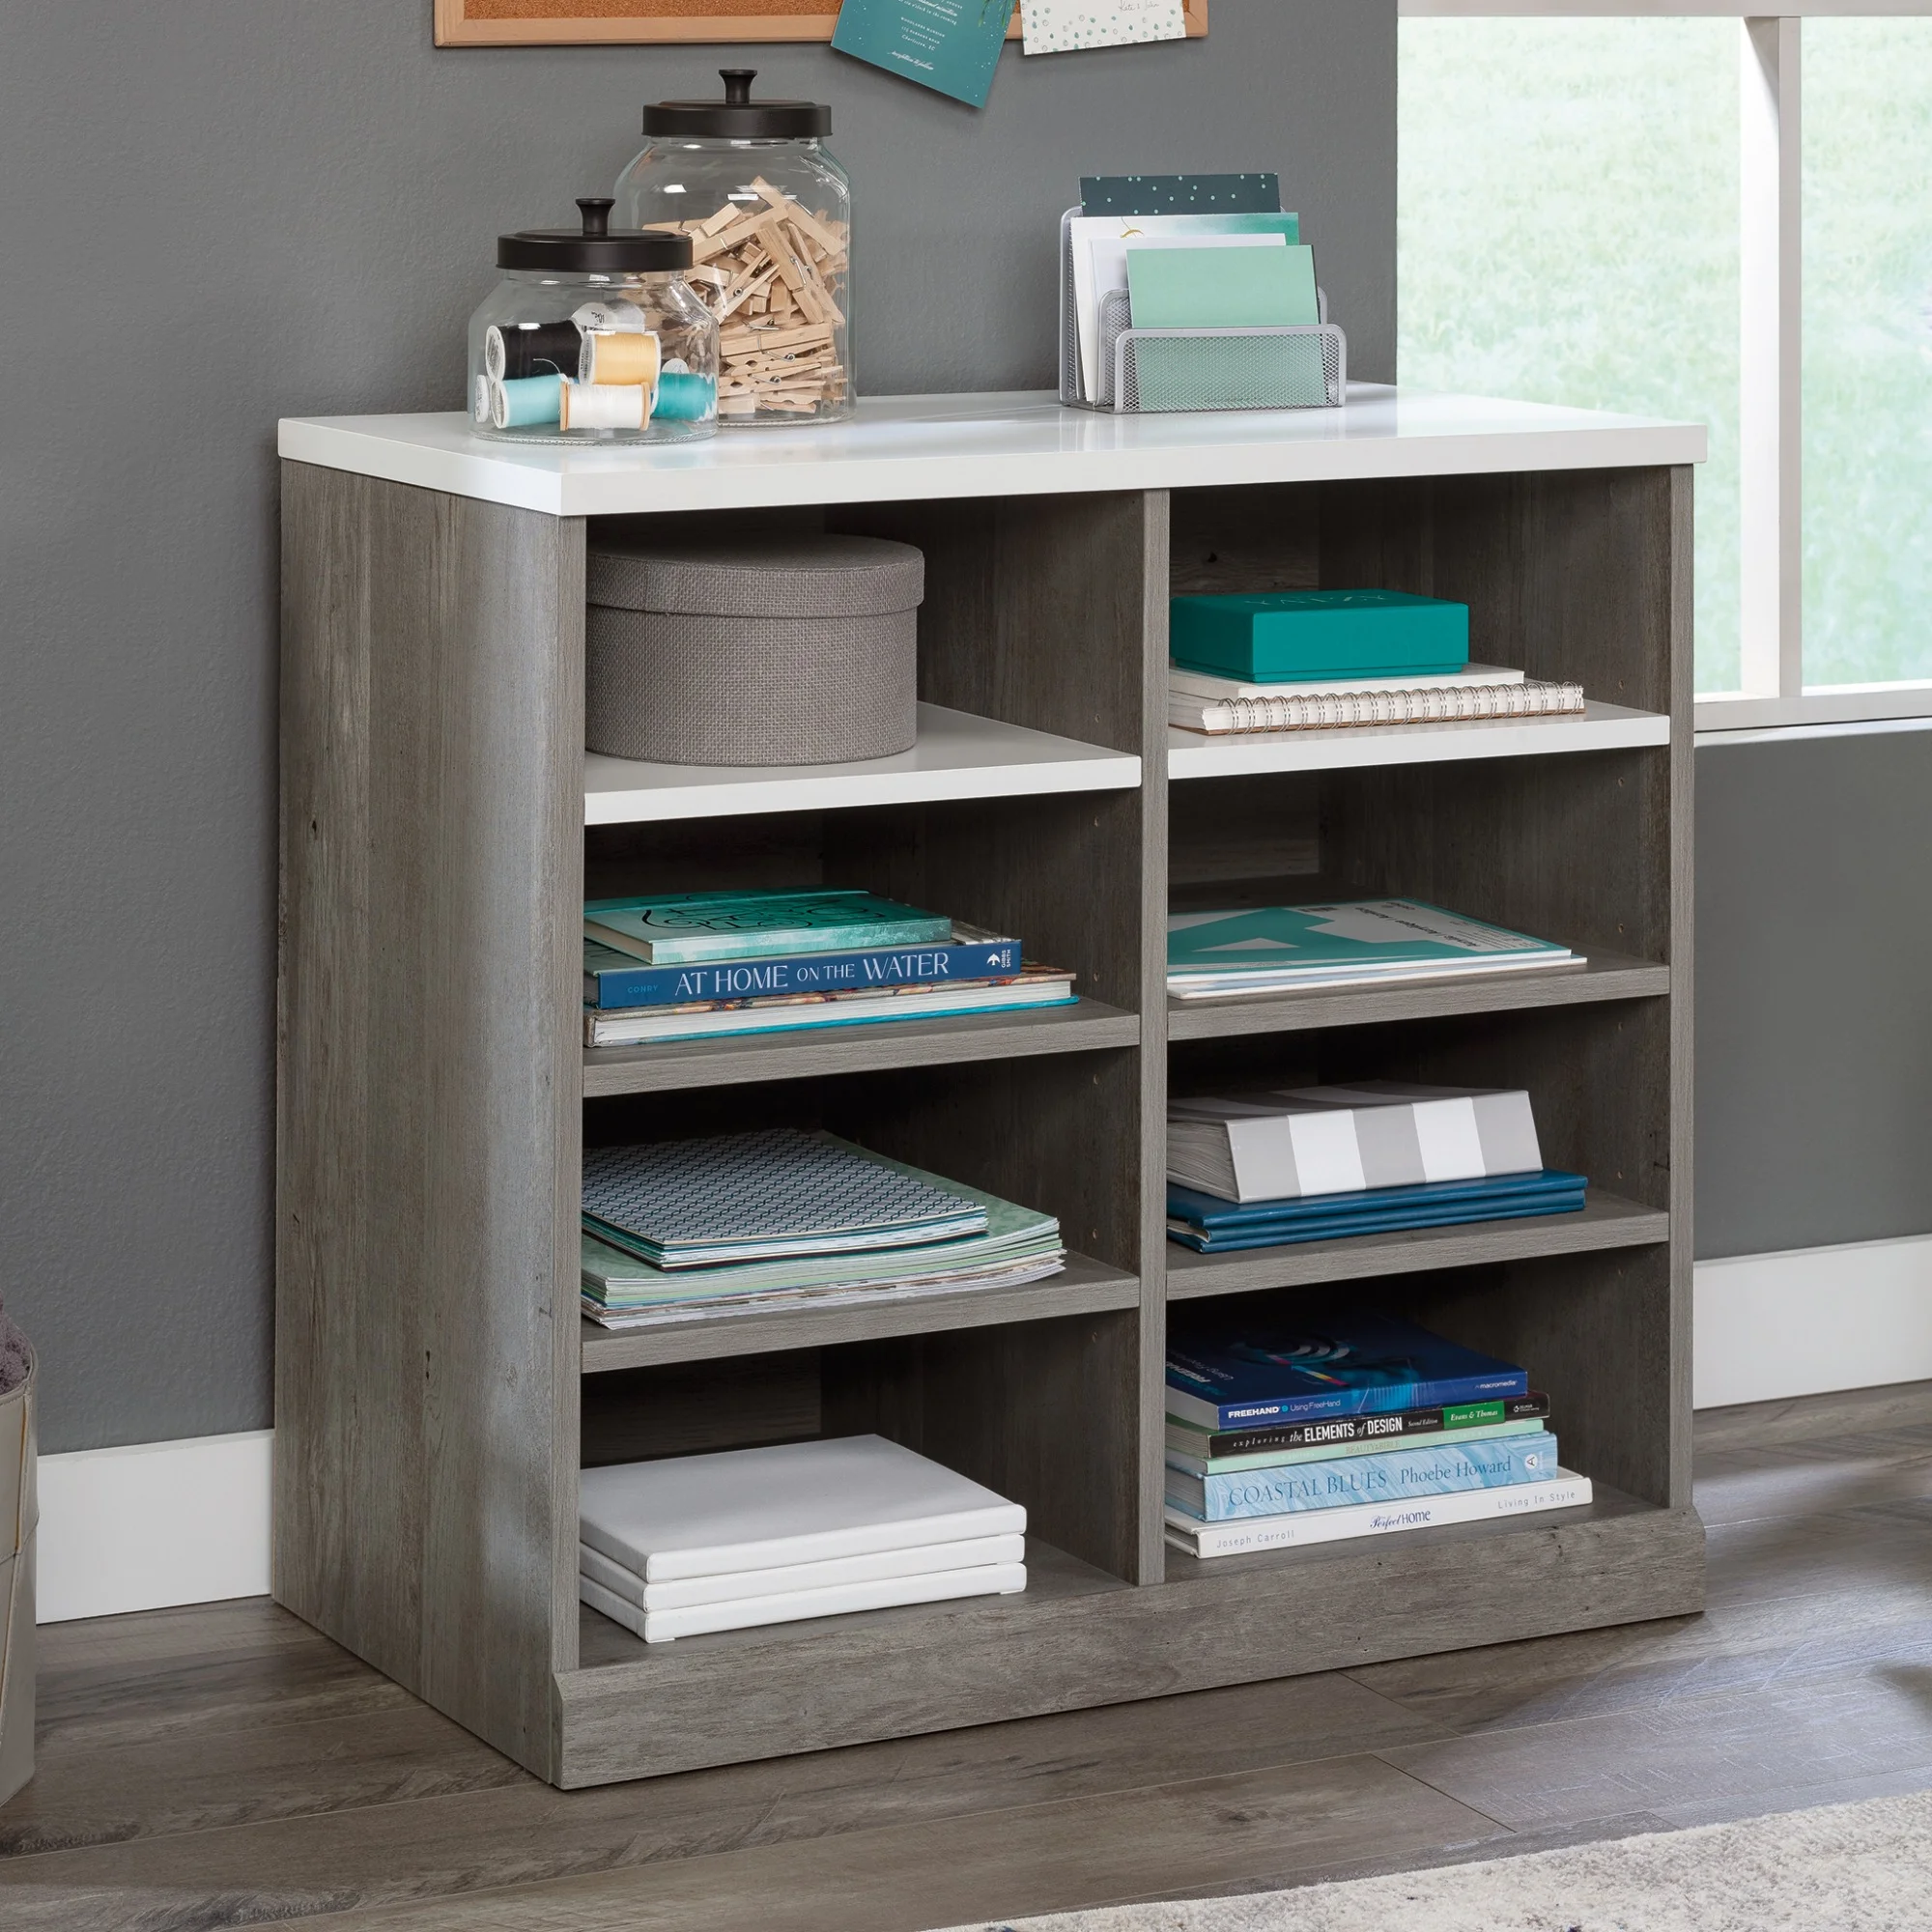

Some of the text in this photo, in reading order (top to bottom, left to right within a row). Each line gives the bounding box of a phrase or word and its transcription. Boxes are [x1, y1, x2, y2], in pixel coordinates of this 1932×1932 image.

[628, 952, 949, 996] CONRY AT HOME ON THE WATER
[1228, 1406, 1279, 1418] FREEHAND
[1290, 1400, 1309, 1412] Using
[1309, 1395, 1341, 1408] FreeHand
[1476, 1409, 1498, 1418] Thomas
[1233, 1416, 1403, 1447] exploring the ELEMENTS of DESIGN
[1422, 1417, 1438, 1426] Edition
[1229, 1478, 1321, 1506] COASTAL
[1327, 1469, 1387, 1494] BLUES
[1401, 1463, 1451, 1484] Phoebe
[1457, 1455, 1512, 1477] Howard
[1497, 1491, 1576, 1510] Living In Style
[1216, 1529, 1294, 1548] Joseph Carroll
